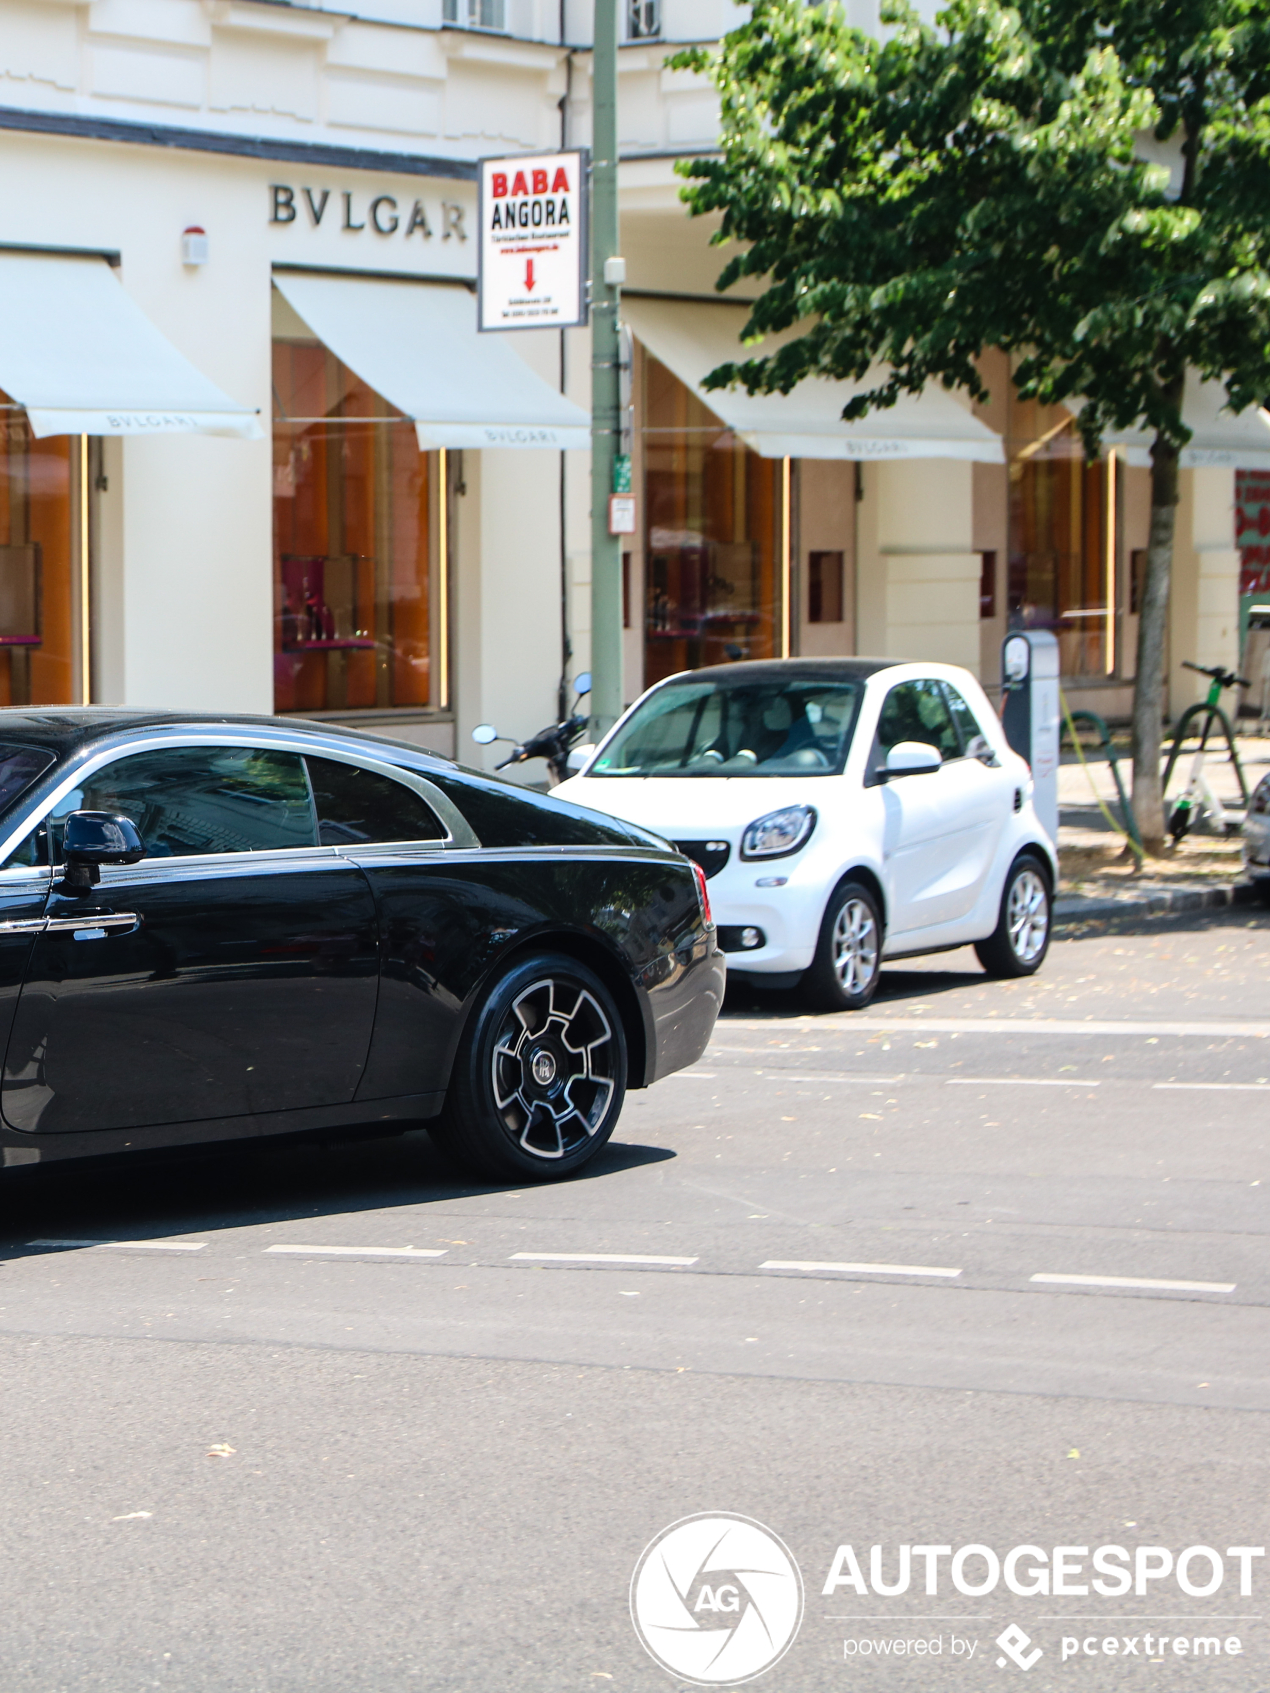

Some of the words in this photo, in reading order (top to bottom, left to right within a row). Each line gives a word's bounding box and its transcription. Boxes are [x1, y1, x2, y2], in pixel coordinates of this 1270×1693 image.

[492, 166, 570, 198] BABA
[269, 184, 468, 241] BVLGAR
[492, 197, 570, 230] ANGORA
[106, 414, 198, 428] BVLGARI
